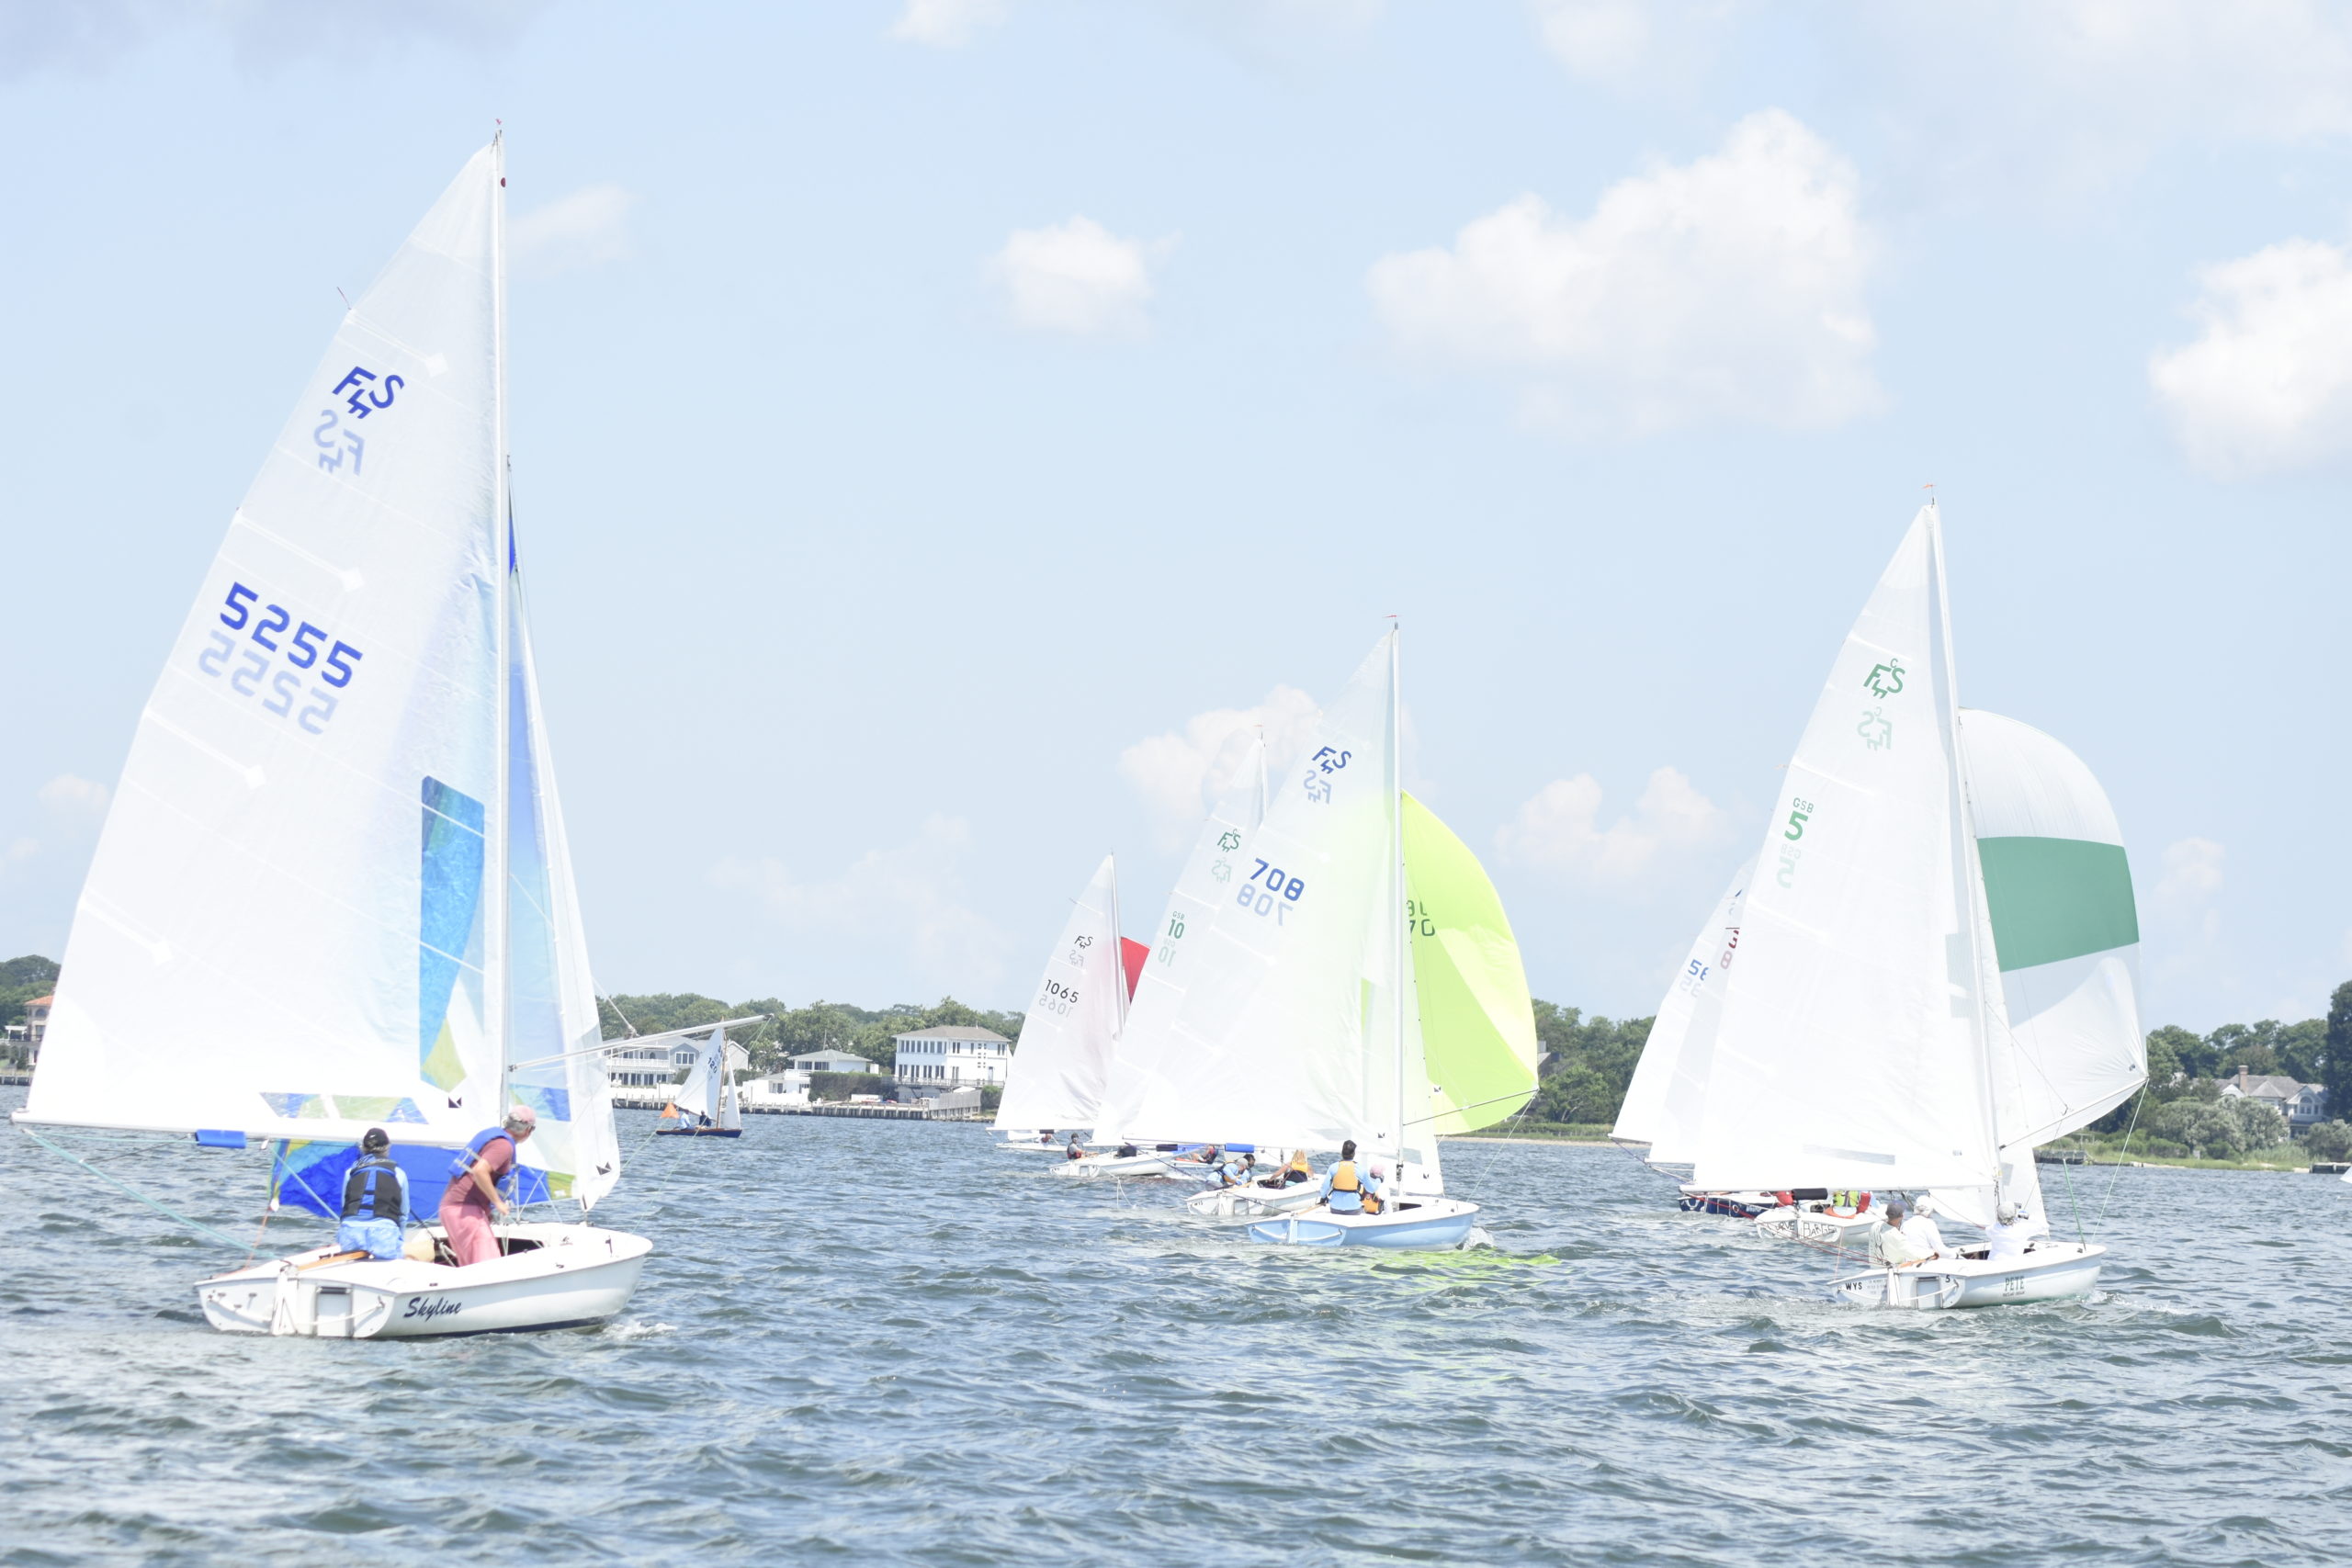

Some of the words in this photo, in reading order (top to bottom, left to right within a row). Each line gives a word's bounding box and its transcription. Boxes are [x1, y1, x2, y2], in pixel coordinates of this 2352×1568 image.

[220, 581, 363, 688] 5255
[1792, 797, 1815, 813] GSB
[1784, 810, 1808, 841] 5
[1250, 857, 1305, 902] 708
[1172, 910, 1185, 919] GSB
[1168, 919, 1185, 939] 10
[1045, 979, 1079, 1003] 1065
[1845, 1281, 1863, 1291] WYS
[1945, 1274, 1951, 1283] 5
[2004, 1275, 2025, 1292] PETE
[403, 1296, 462, 1322] Skyline
